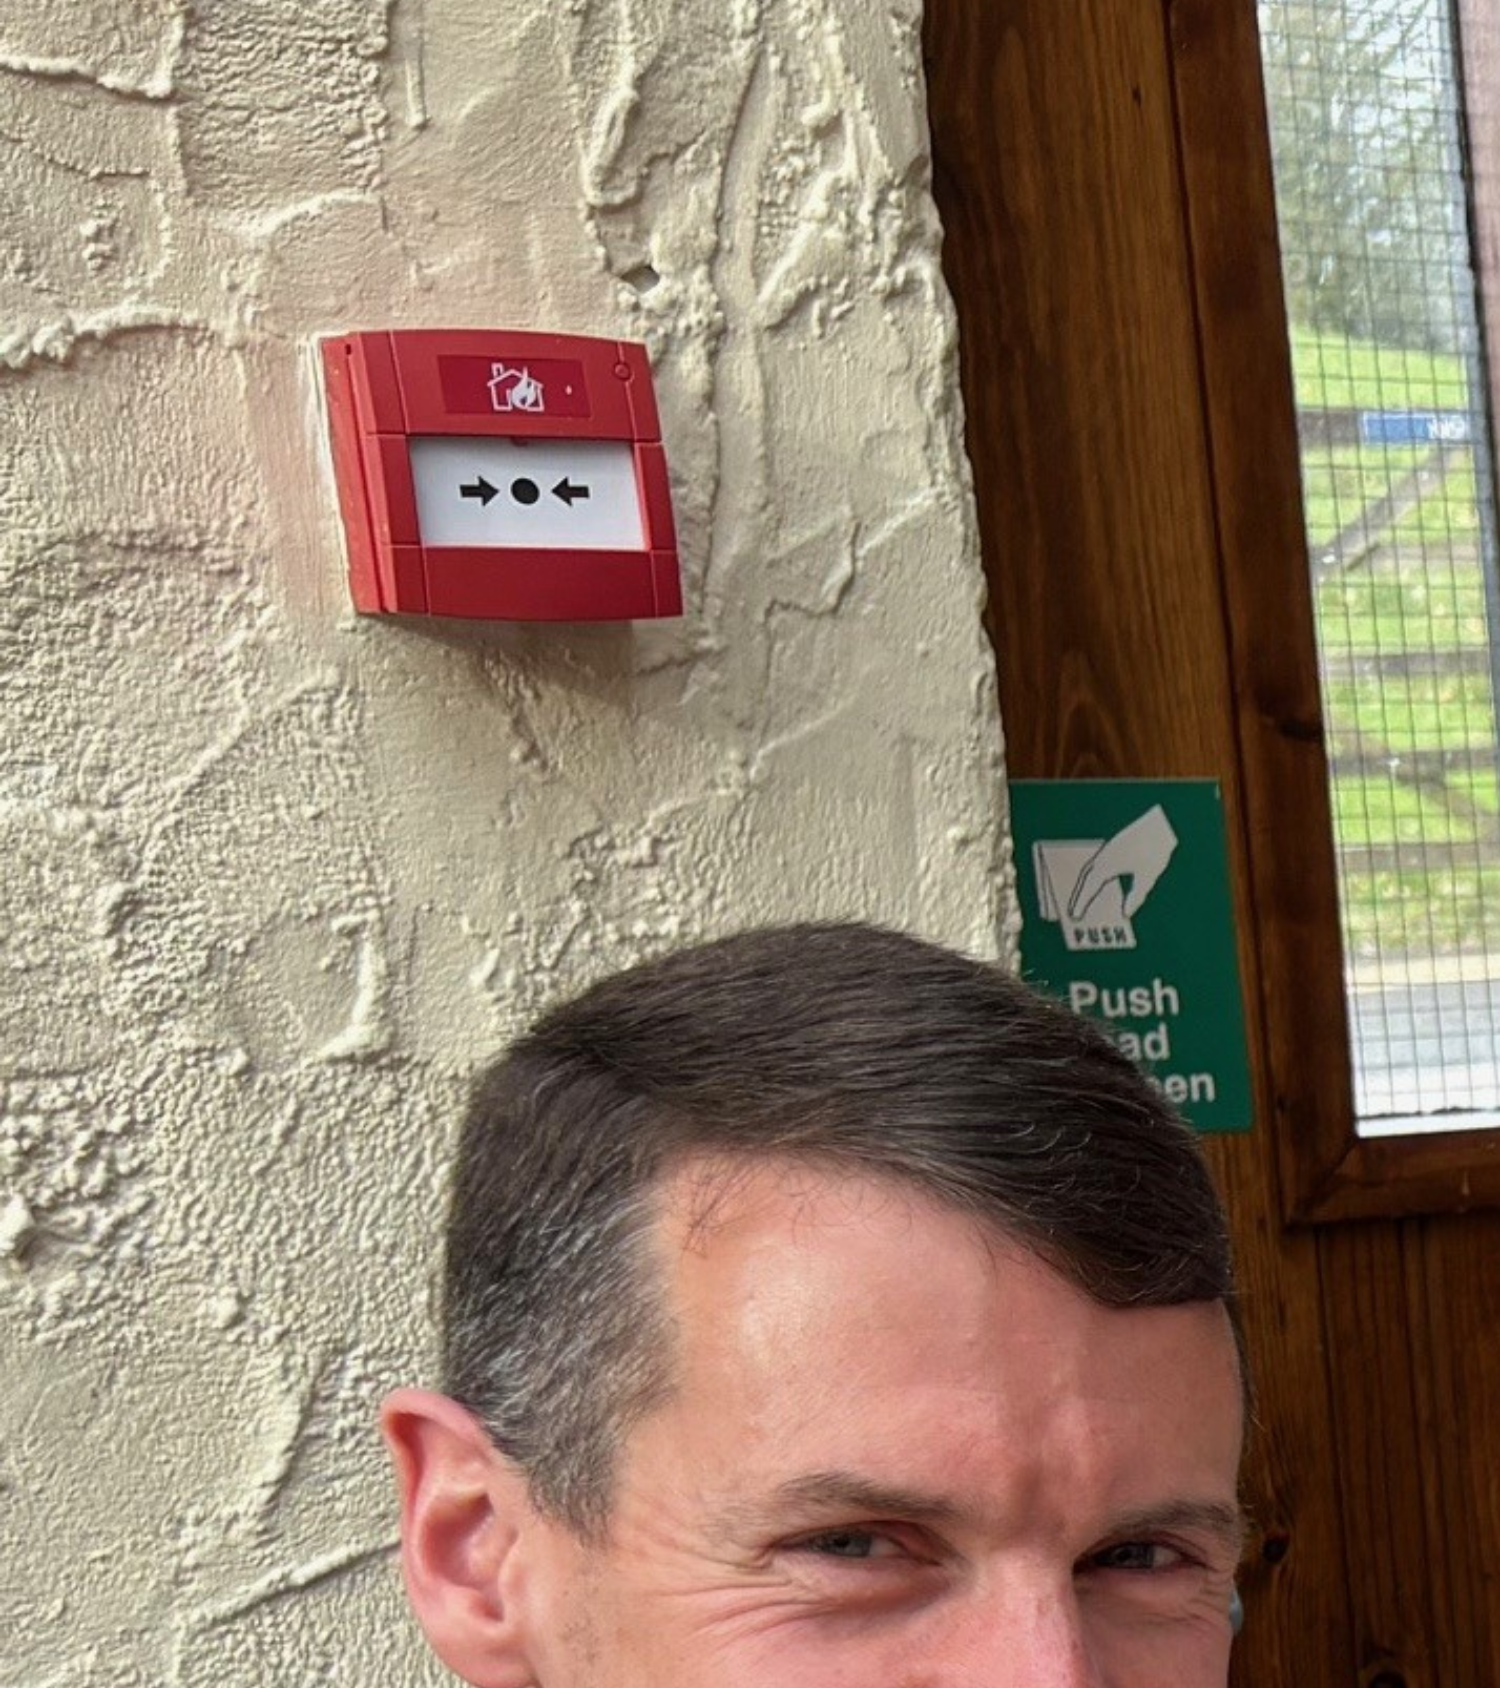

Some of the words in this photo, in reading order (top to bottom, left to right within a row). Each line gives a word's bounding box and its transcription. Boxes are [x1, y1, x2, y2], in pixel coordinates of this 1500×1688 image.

[1073, 927, 1128, 944] PUSH
[1069, 977, 1180, 1018] Push
[1102, 1021, 1171, 1061] ad
